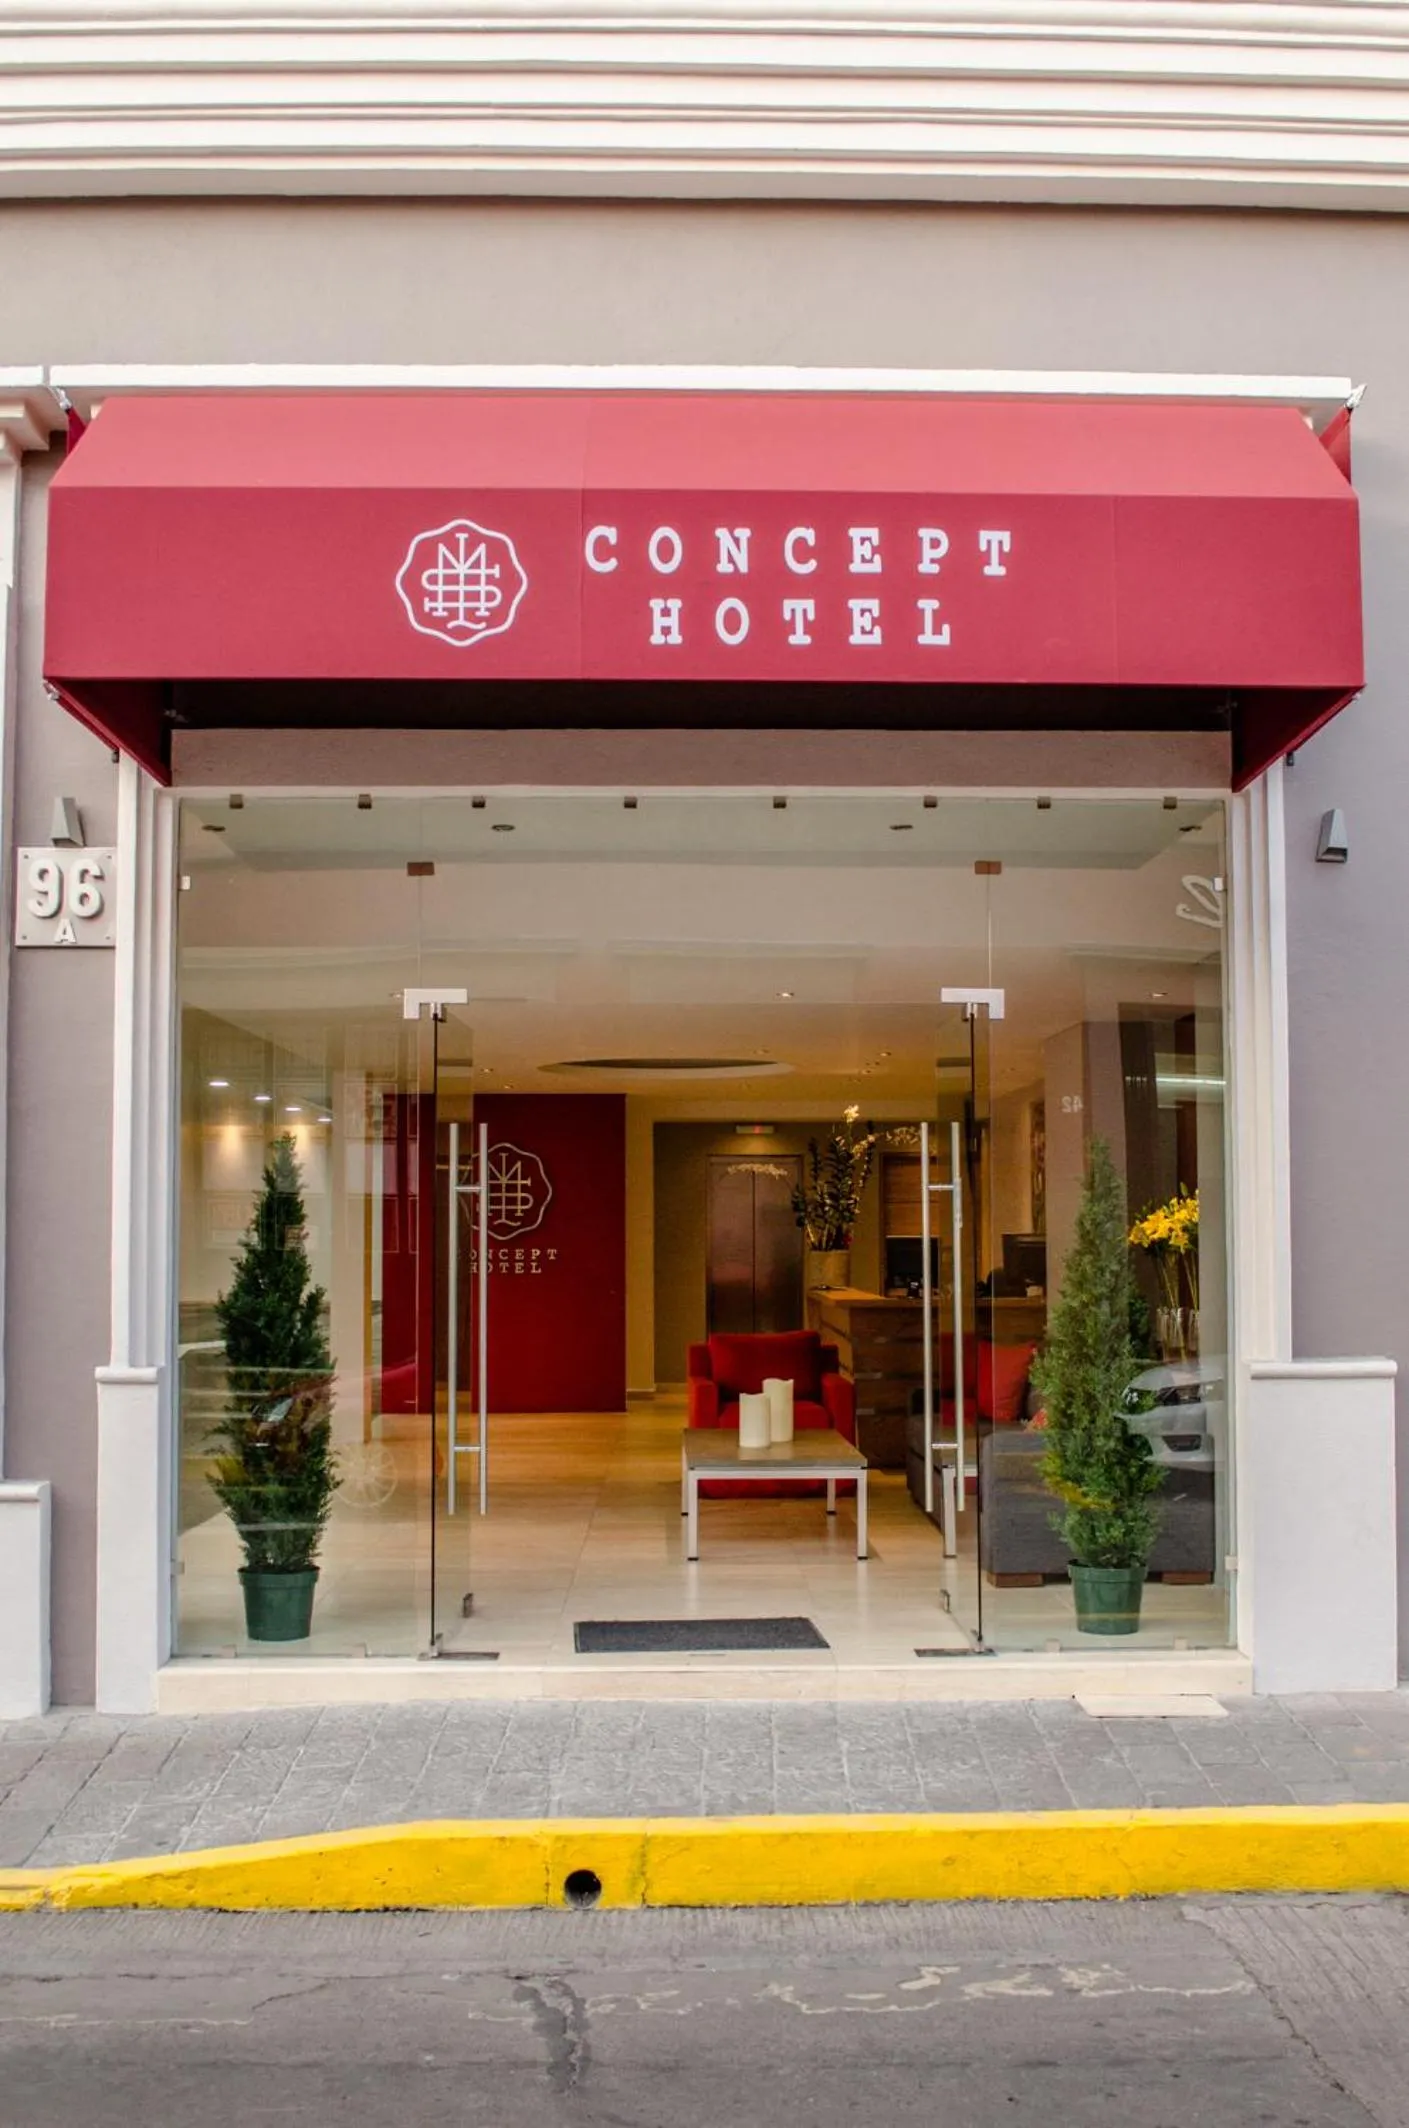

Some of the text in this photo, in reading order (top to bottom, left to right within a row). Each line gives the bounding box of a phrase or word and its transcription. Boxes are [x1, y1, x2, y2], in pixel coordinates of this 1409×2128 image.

[584, 526, 1011, 576] CONCEPT
[648, 597, 951, 645] HOTEL
[27, 859, 103, 919] 96
[53, 918, 77, 944] A
[457, 1248, 558, 1261] ONCEPT
